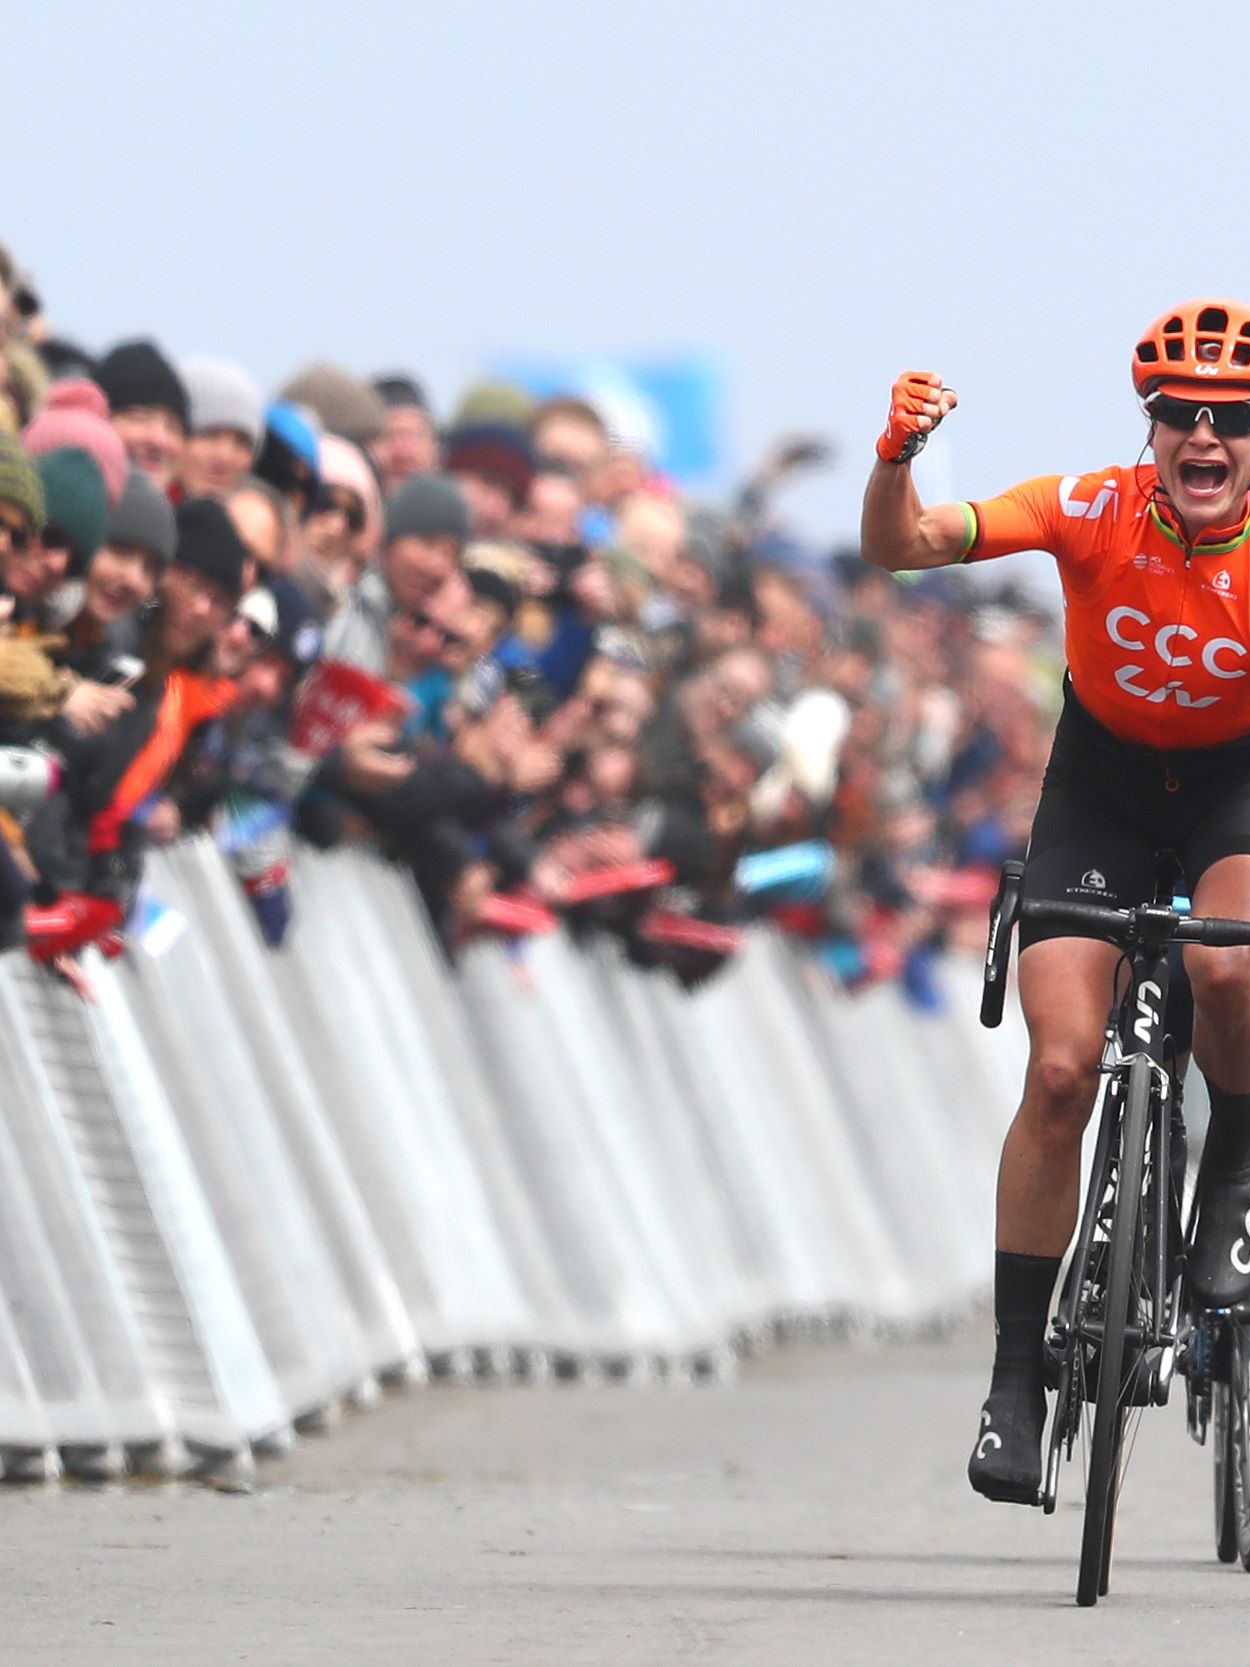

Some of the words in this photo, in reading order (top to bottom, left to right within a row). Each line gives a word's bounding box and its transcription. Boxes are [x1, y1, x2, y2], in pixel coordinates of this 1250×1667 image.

[1058, 475, 1119, 520] Li
[1105, 605, 1248, 679] CCC
[1114, 664, 1222, 708] Liv
[1133, 980, 1162, 1045] Liv
